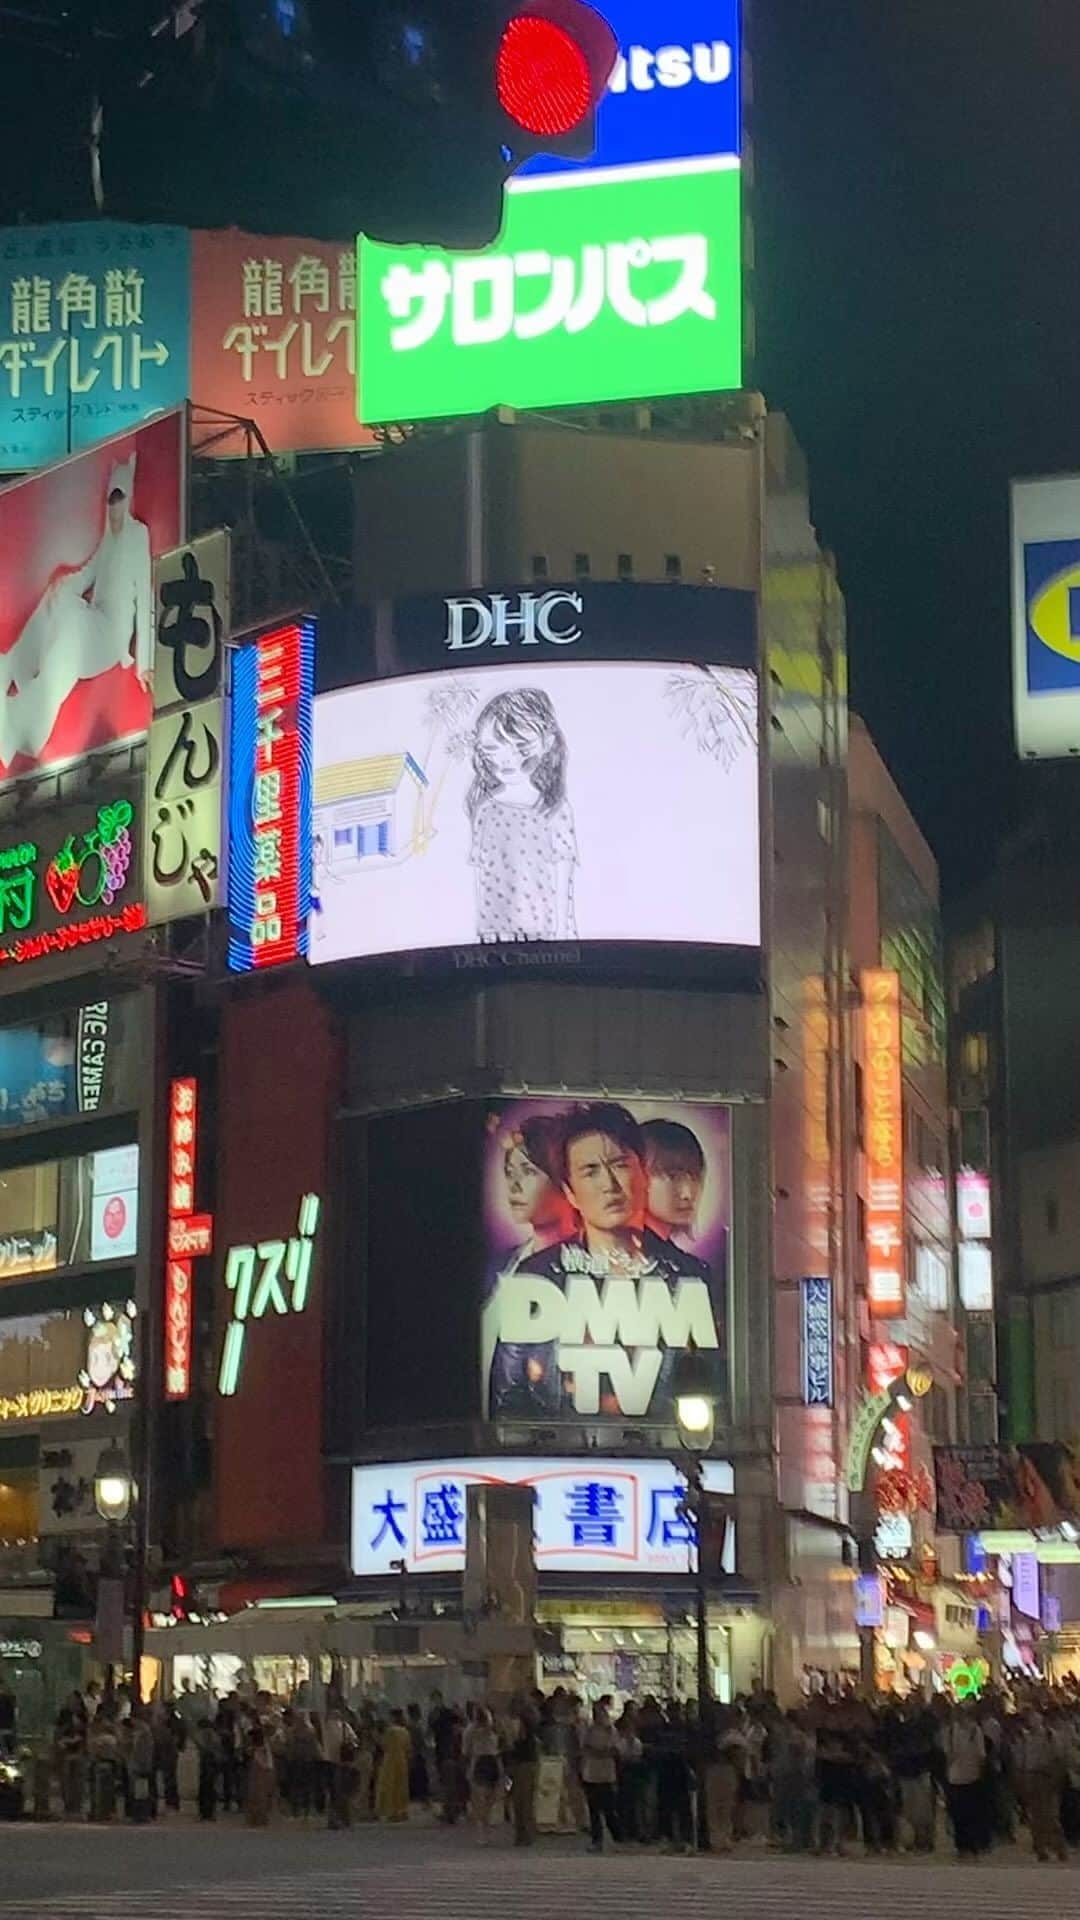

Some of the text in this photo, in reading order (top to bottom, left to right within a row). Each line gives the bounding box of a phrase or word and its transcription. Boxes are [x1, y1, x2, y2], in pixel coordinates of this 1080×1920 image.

[11, 268, 145, 334] 龍角散
[381, 234, 717, 351] サロンパス
[0, 333, 169, 398] ダイレクト
[443, 590, 583, 650] DHC
[152, 552, 222, 903] もんじゃ
[250, 645, 284, 946] 三千里薬品
[219, 1192, 320, 1395] クスリ
[494, 1272, 719, 1348] DMM
[557, 1345, 663, 1416] TV
[369, 1482, 699, 1550] 大盛書店
